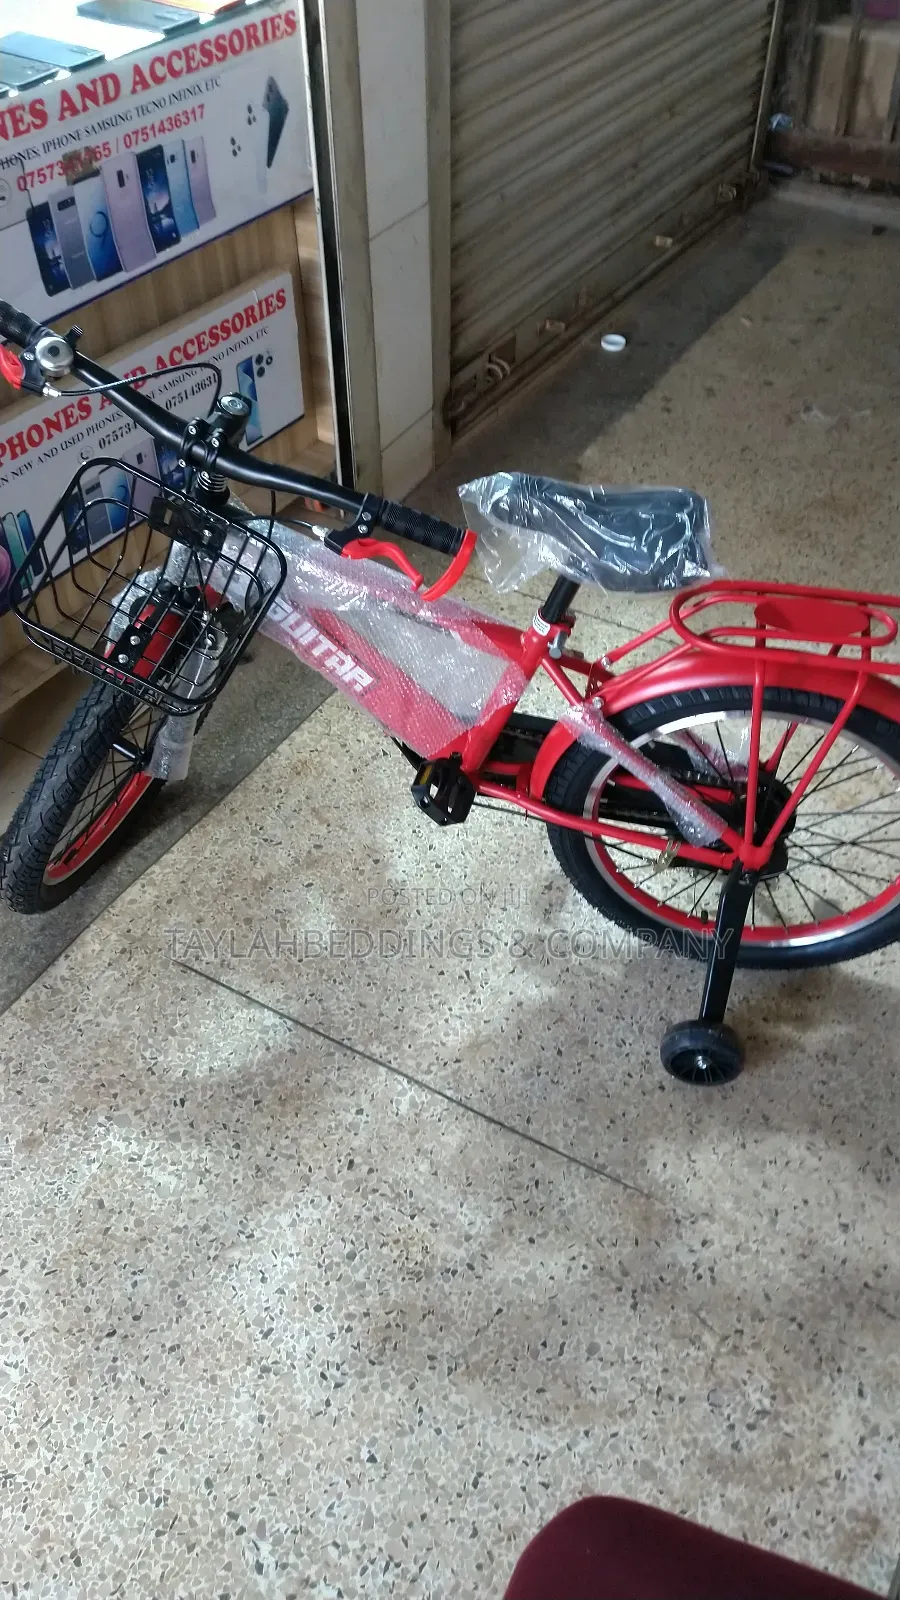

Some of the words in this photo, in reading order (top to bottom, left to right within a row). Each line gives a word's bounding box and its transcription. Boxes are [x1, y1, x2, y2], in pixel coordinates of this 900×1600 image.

[58, 72, 121, 122] AND
[130, 9, 297, 95] ACCESSORIES
[41, 128, 82, 154] IPHONE
[84, 110, 133, 137] SAMSUNG
[135, 96, 167, 118] TECNO
[123, 103, 205, 149] 0751436317
[154, 288, 287, 378] ACCESSORIES
[11, 461, 33, 482] NEW
[37, 447, 58, 467] AND
[60, 432, 84, 451] USED
[158, 369, 197, 396] SAMSUNG
